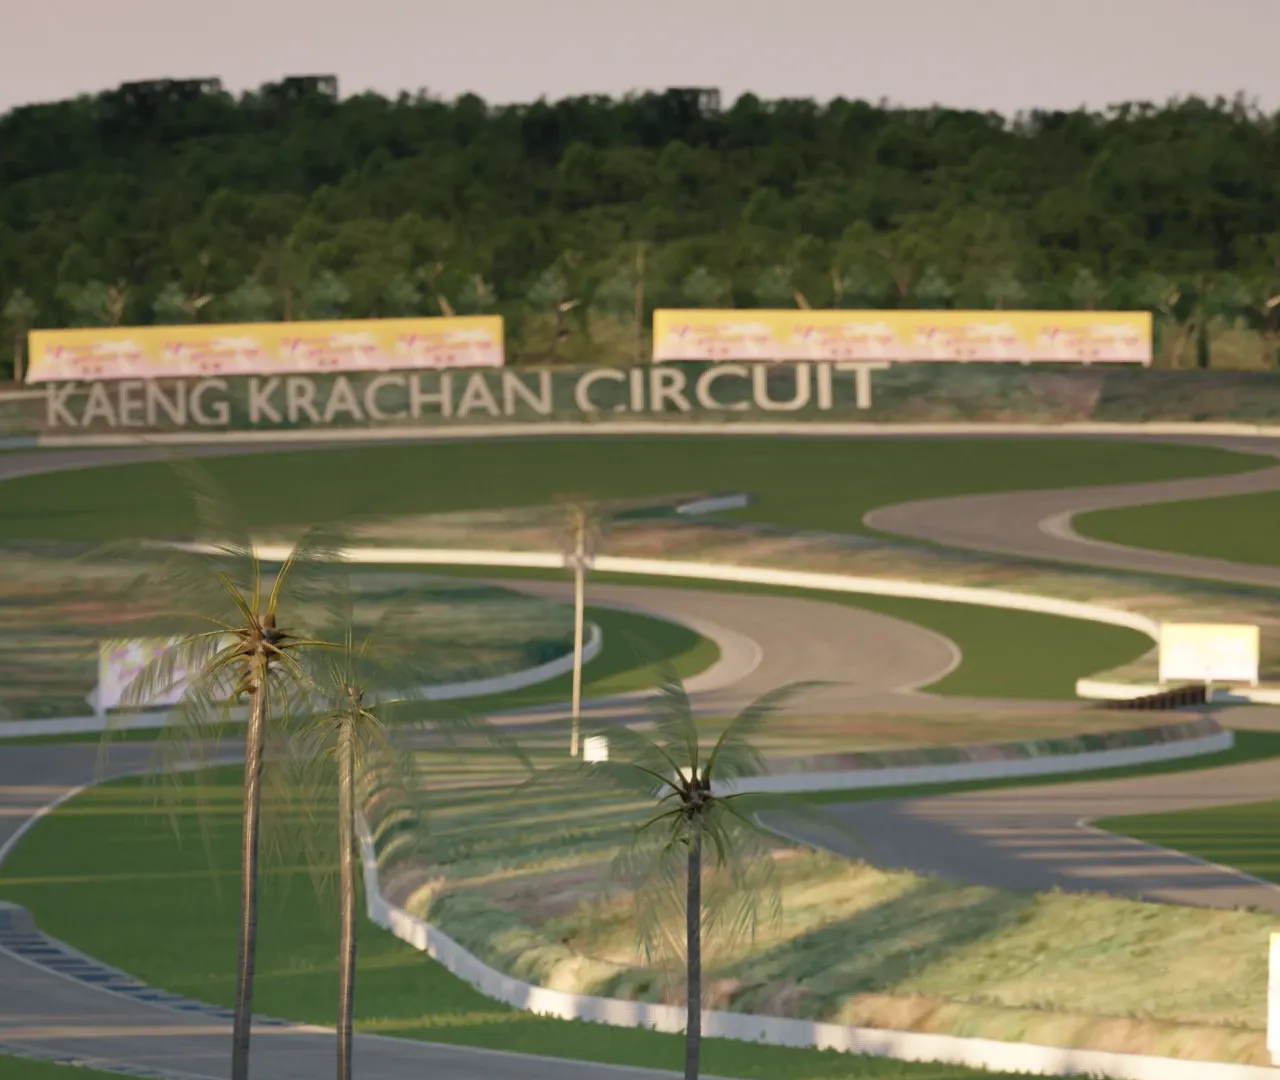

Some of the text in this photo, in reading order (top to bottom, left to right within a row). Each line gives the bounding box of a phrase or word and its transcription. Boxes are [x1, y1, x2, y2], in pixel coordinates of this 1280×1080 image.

[45, 361, 891, 428] KAENG KRACHAN CIRCUIT
